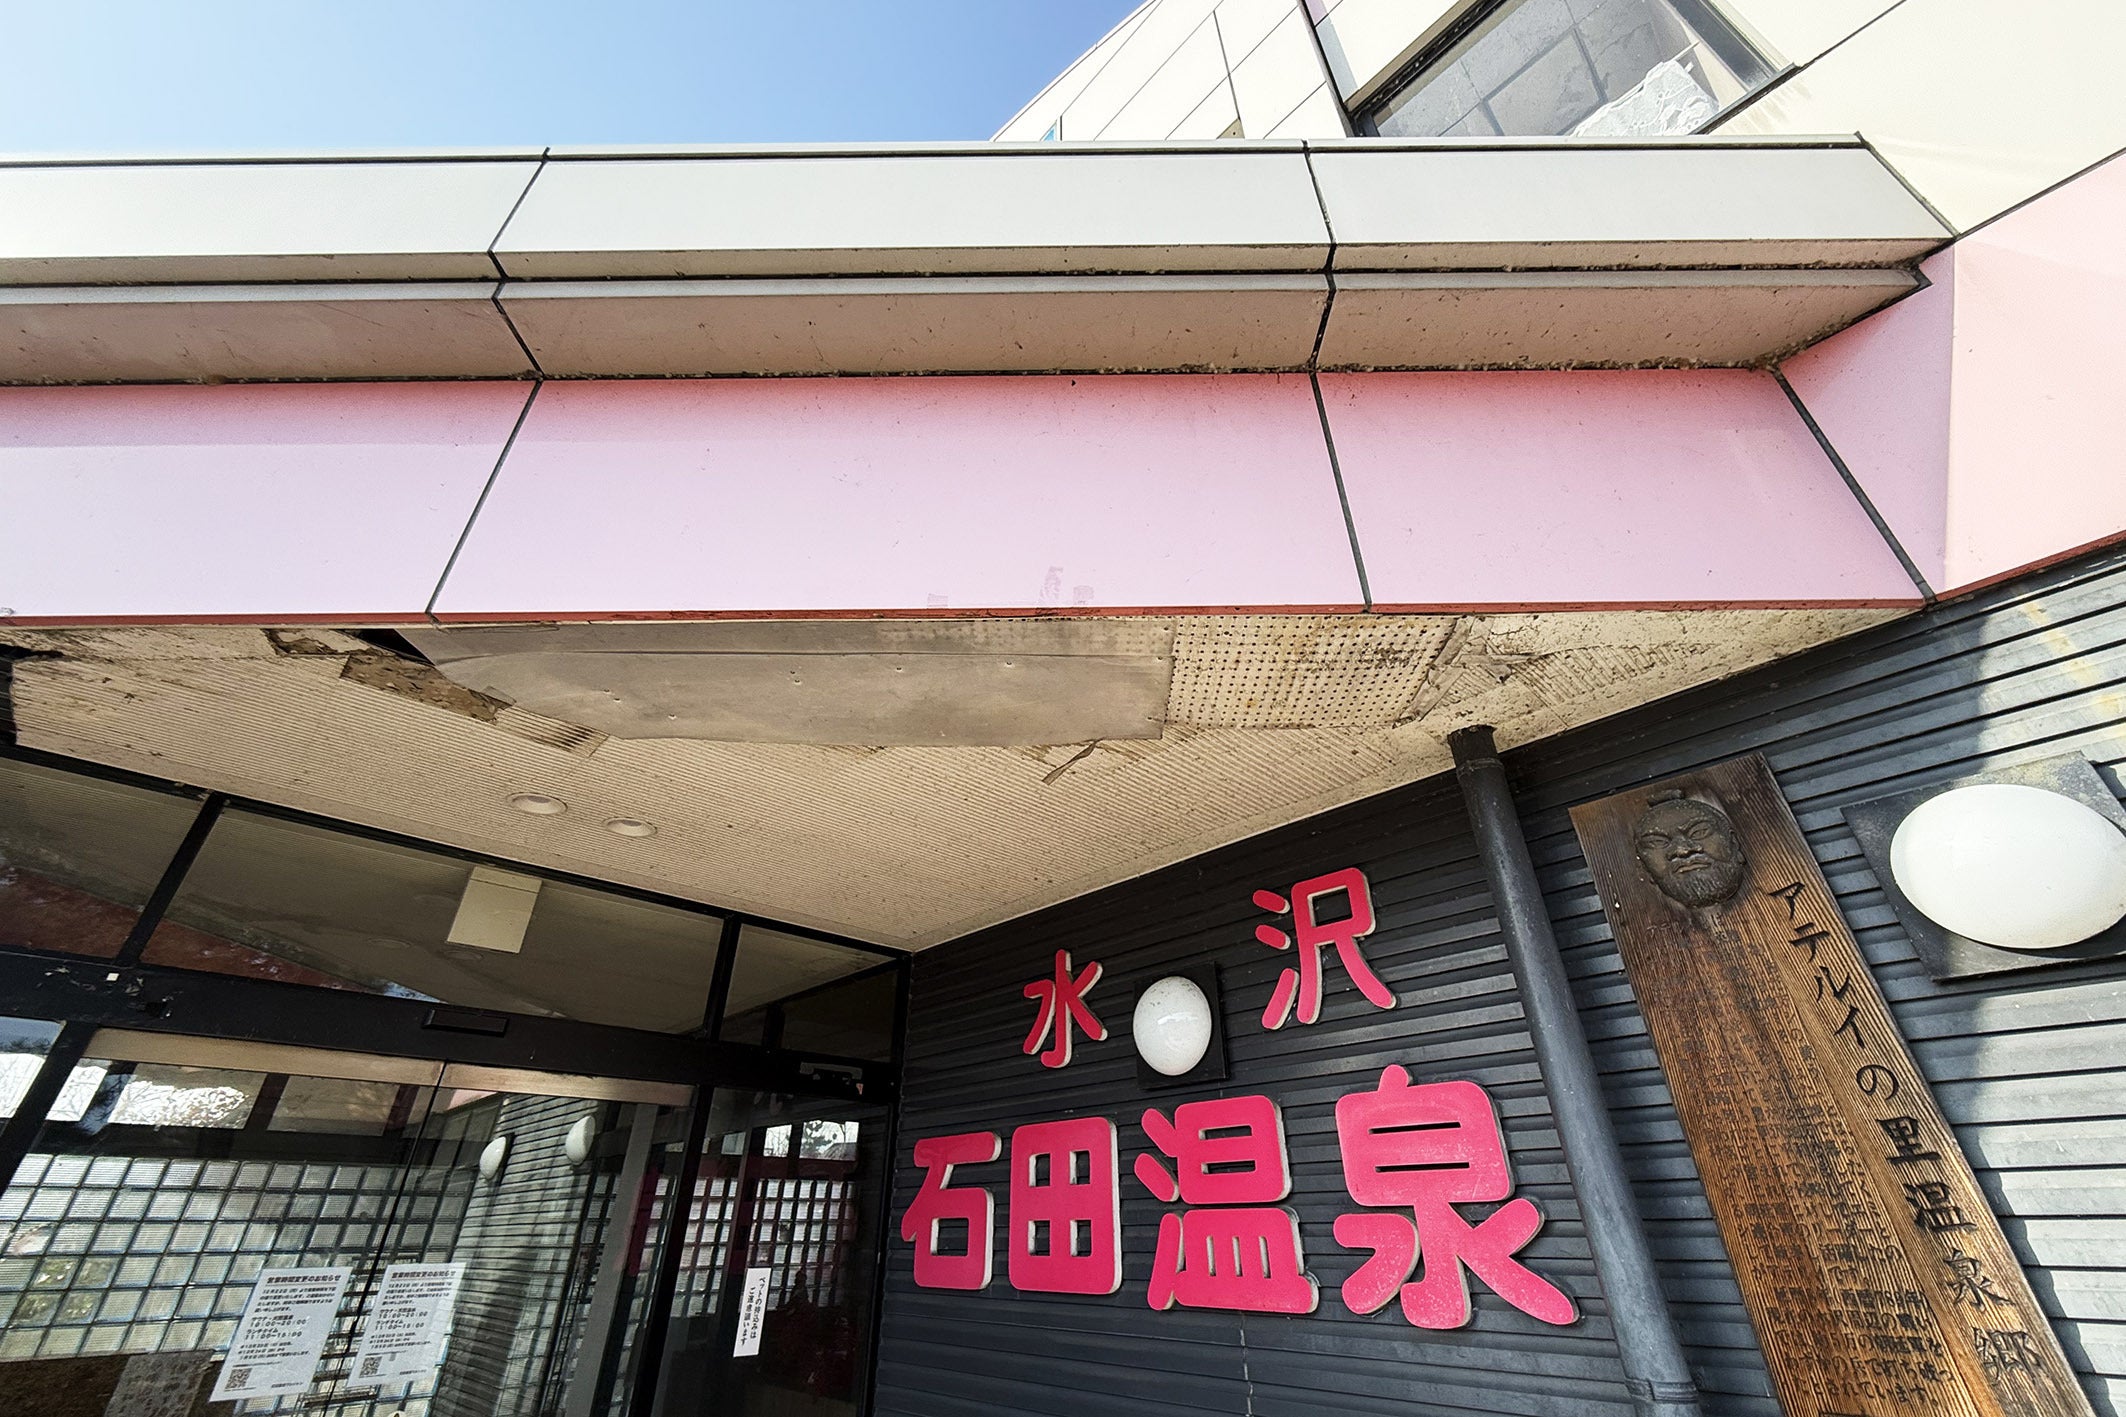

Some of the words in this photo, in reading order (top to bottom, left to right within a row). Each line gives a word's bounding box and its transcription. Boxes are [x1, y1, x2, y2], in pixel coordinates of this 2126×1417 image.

[900, 1063, 1579, 1329] 石田温泉
[1768, 881, 2046, 1386] アテルイの里温泉郷
[266, 1274, 341, 1283] 営業時間変更のお知らせ
[391, 1270, 456, 1278] 営業時間変更のお知らせ
